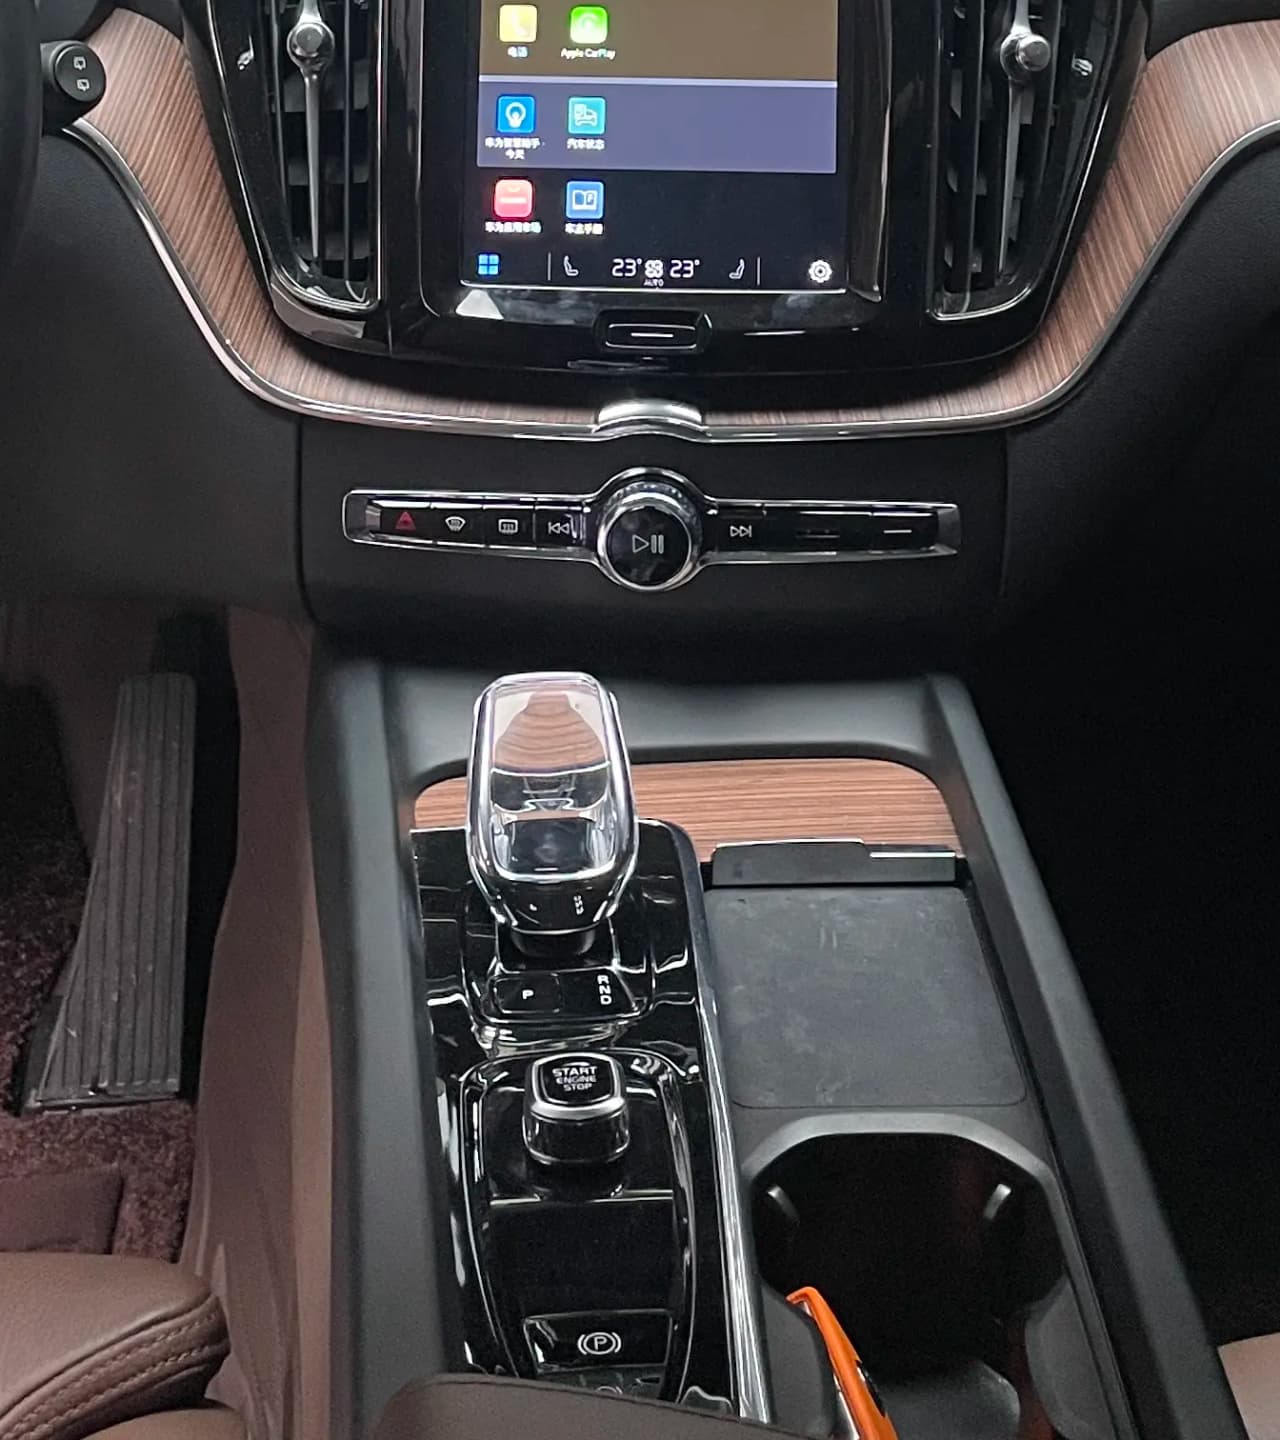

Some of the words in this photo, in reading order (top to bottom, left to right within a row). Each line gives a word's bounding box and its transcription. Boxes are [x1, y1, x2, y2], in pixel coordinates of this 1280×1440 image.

[507, 46, 528, 58] 电话
[560, 48, 583, 59] Apple
[585, 48, 616, 60] CarPlay
[522, 989, 534, 1000] P
[552, 1066, 598, 1077] START
[556, 1075, 598, 1085] ENGINE
[563, 1082, 593, 1092] STOP
